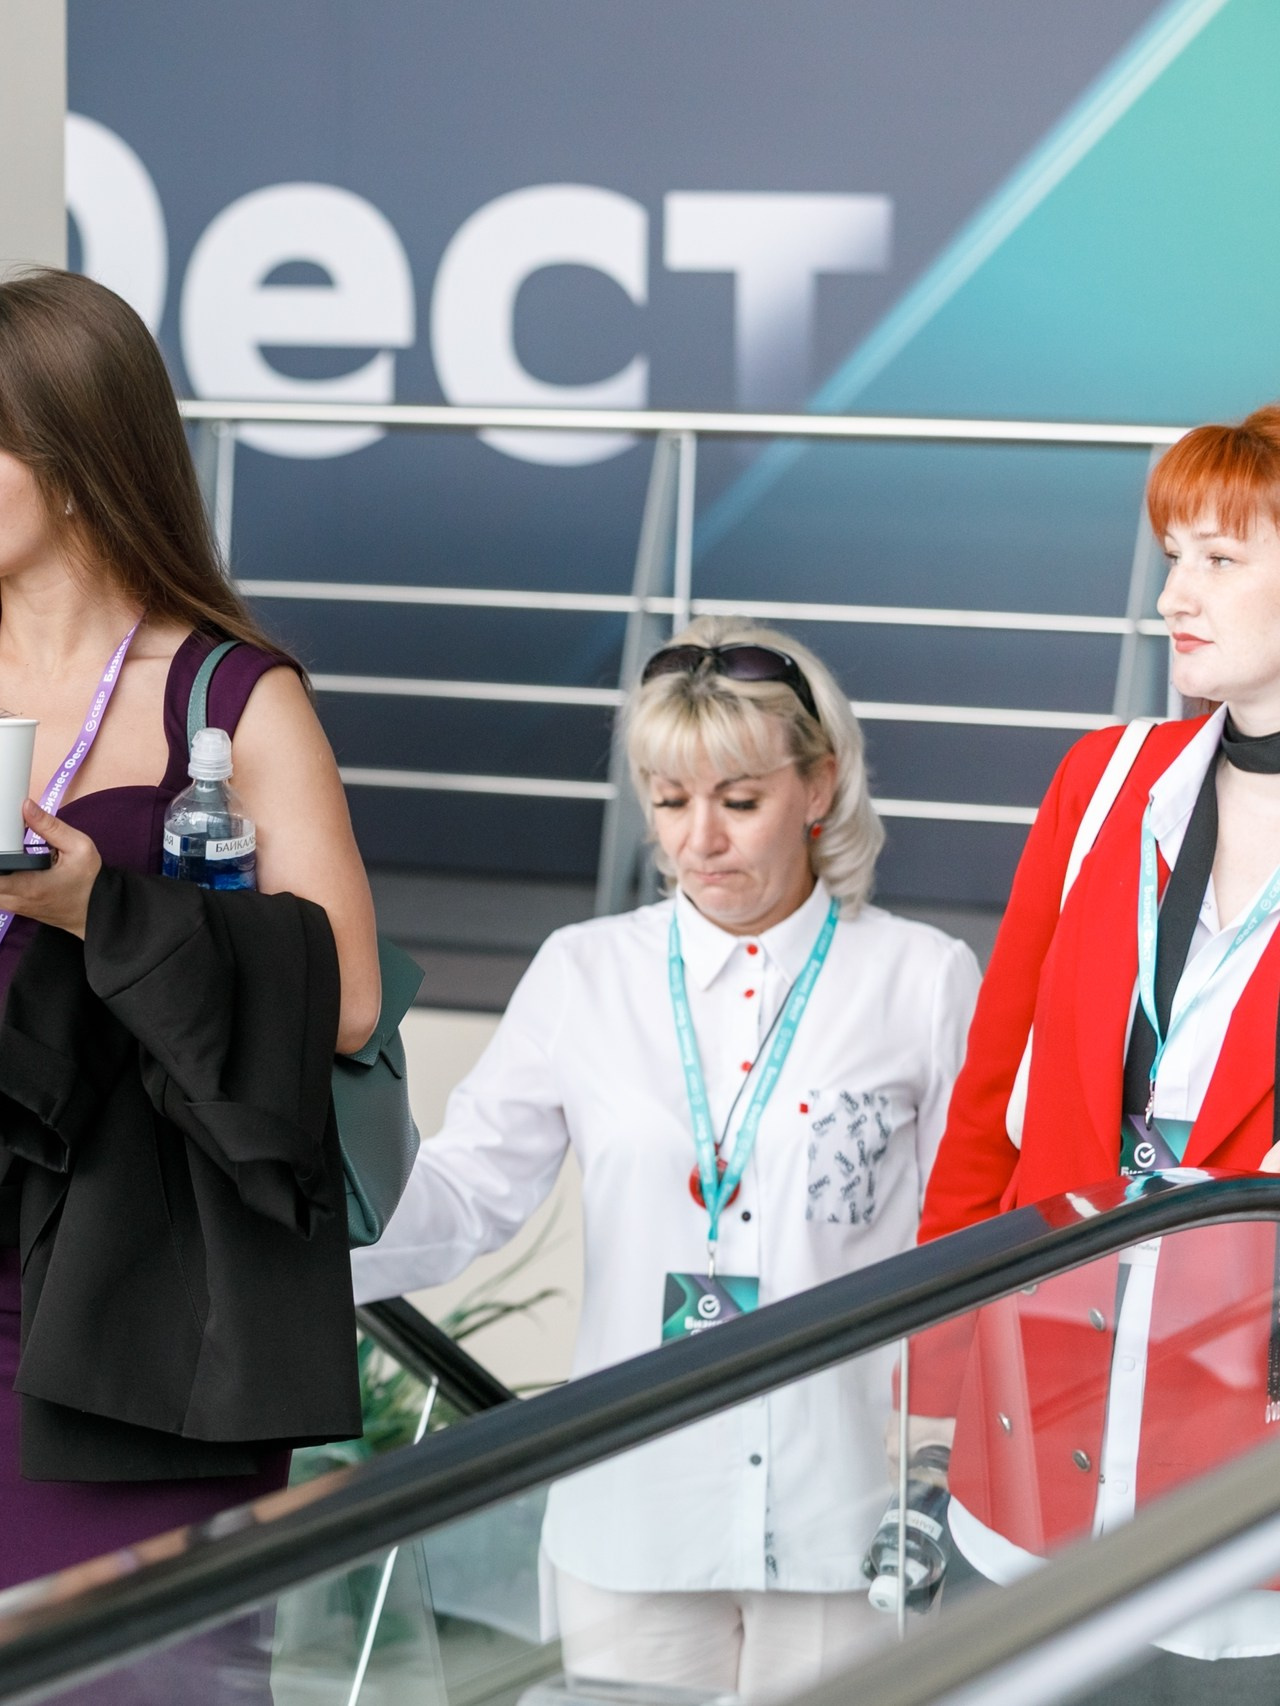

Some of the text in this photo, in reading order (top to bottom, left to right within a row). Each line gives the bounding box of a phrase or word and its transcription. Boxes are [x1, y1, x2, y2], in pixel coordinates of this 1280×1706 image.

[91, 638, 129, 718] СБЕР Бизнес
[64, 740, 88, 769] Фест
